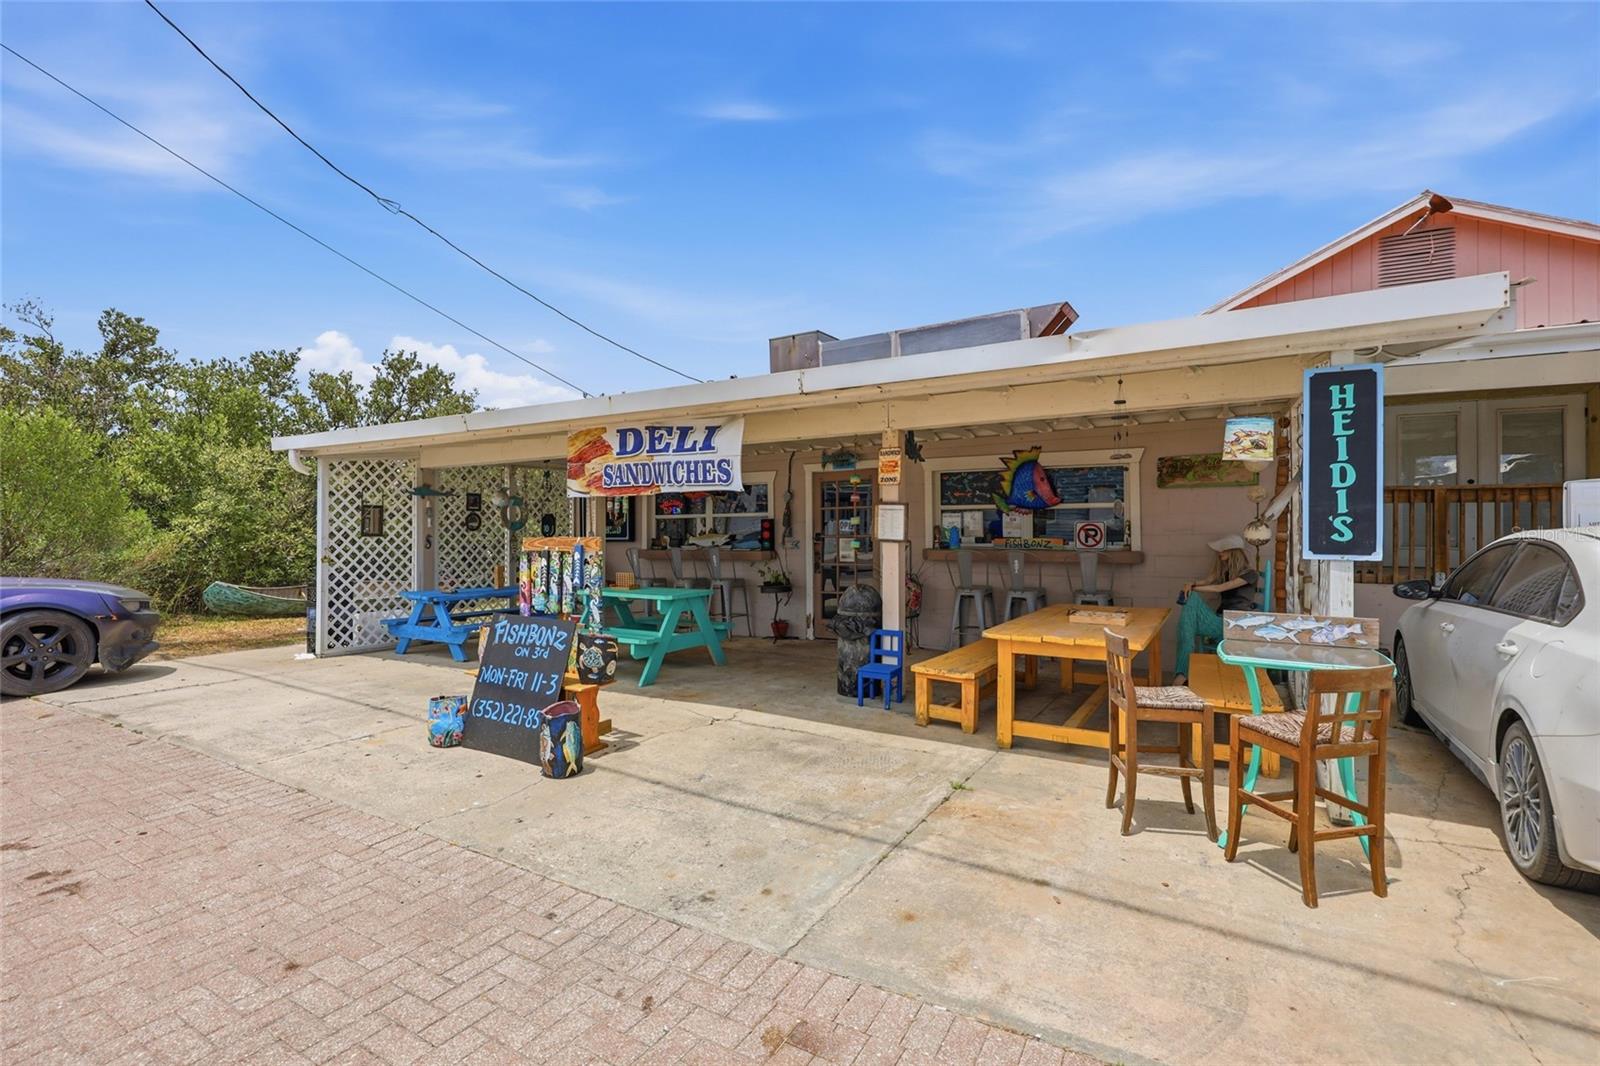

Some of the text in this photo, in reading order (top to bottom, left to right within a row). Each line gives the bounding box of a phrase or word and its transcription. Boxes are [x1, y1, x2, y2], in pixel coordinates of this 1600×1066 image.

[615, 425, 721, 456] DELI
[602, 458, 733, 487] SANDWICHES
[1328, 383, 1357, 543] HEIDI'S
[492, 619, 568, 652] FISHBONZ
[514, 646, 550, 659] ON 3rd
[478, 664, 560, 696] MON-FRI 11-3
